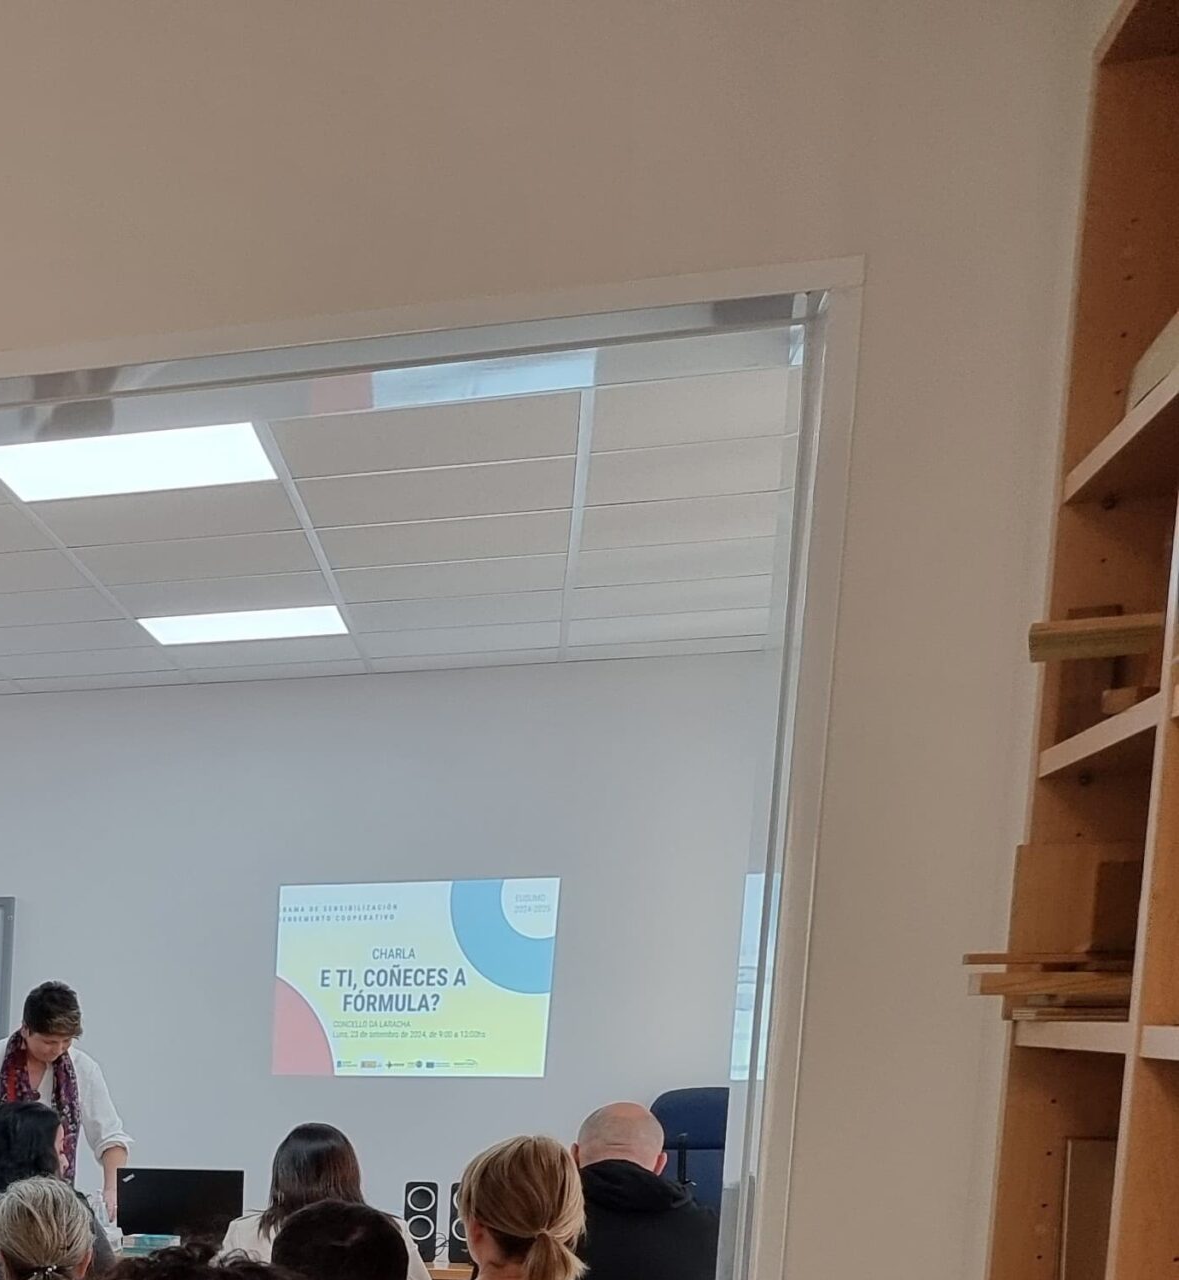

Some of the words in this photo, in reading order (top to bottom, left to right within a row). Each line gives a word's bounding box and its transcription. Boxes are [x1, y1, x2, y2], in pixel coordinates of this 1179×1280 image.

[372, 947, 416, 960] CHARLA
[320, 969, 331, 987] E
[335, 969, 357, 990] TI,
[363, 965, 448, 987] COÑECES
[453, 967, 466, 986] A
[343, 989, 440, 1012] FÓRMULA?
